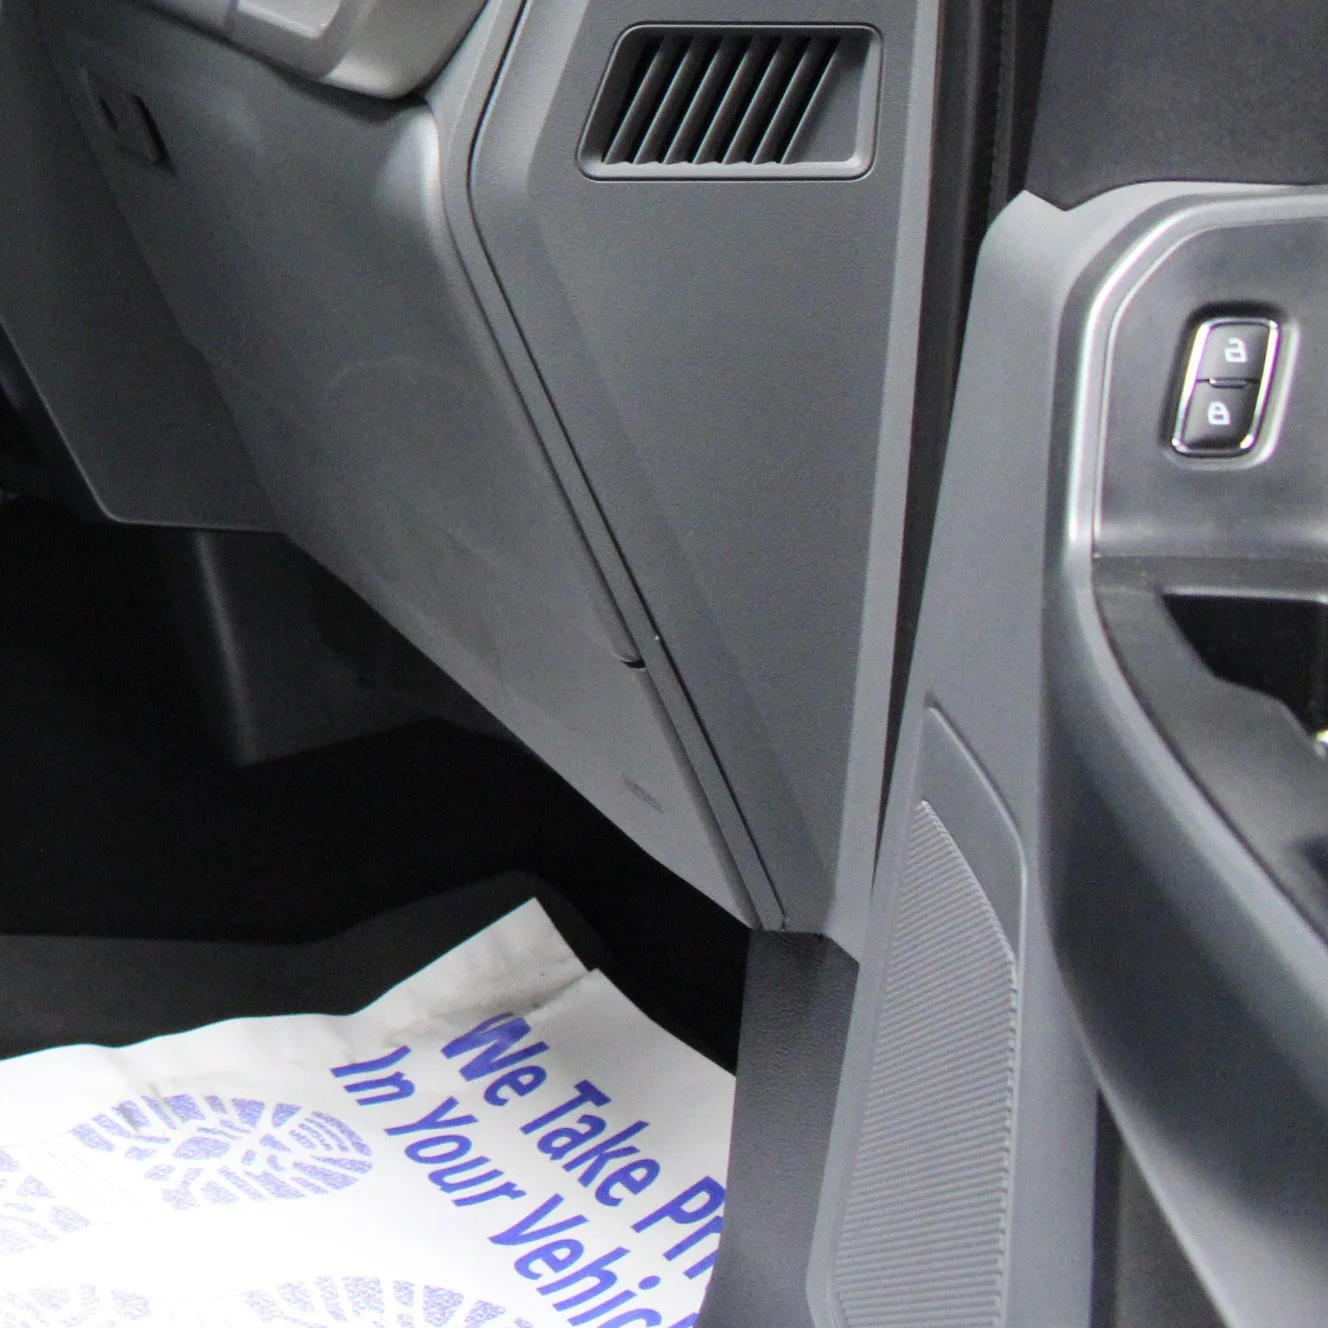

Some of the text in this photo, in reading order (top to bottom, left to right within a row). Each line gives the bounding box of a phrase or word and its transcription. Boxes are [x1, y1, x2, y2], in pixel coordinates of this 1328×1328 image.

[330, 1045, 416, 1106] In
[383, 1096, 528, 1208] Your
[440, 1012, 550, 1107] We
[519, 1079, 661, 1207] Take
